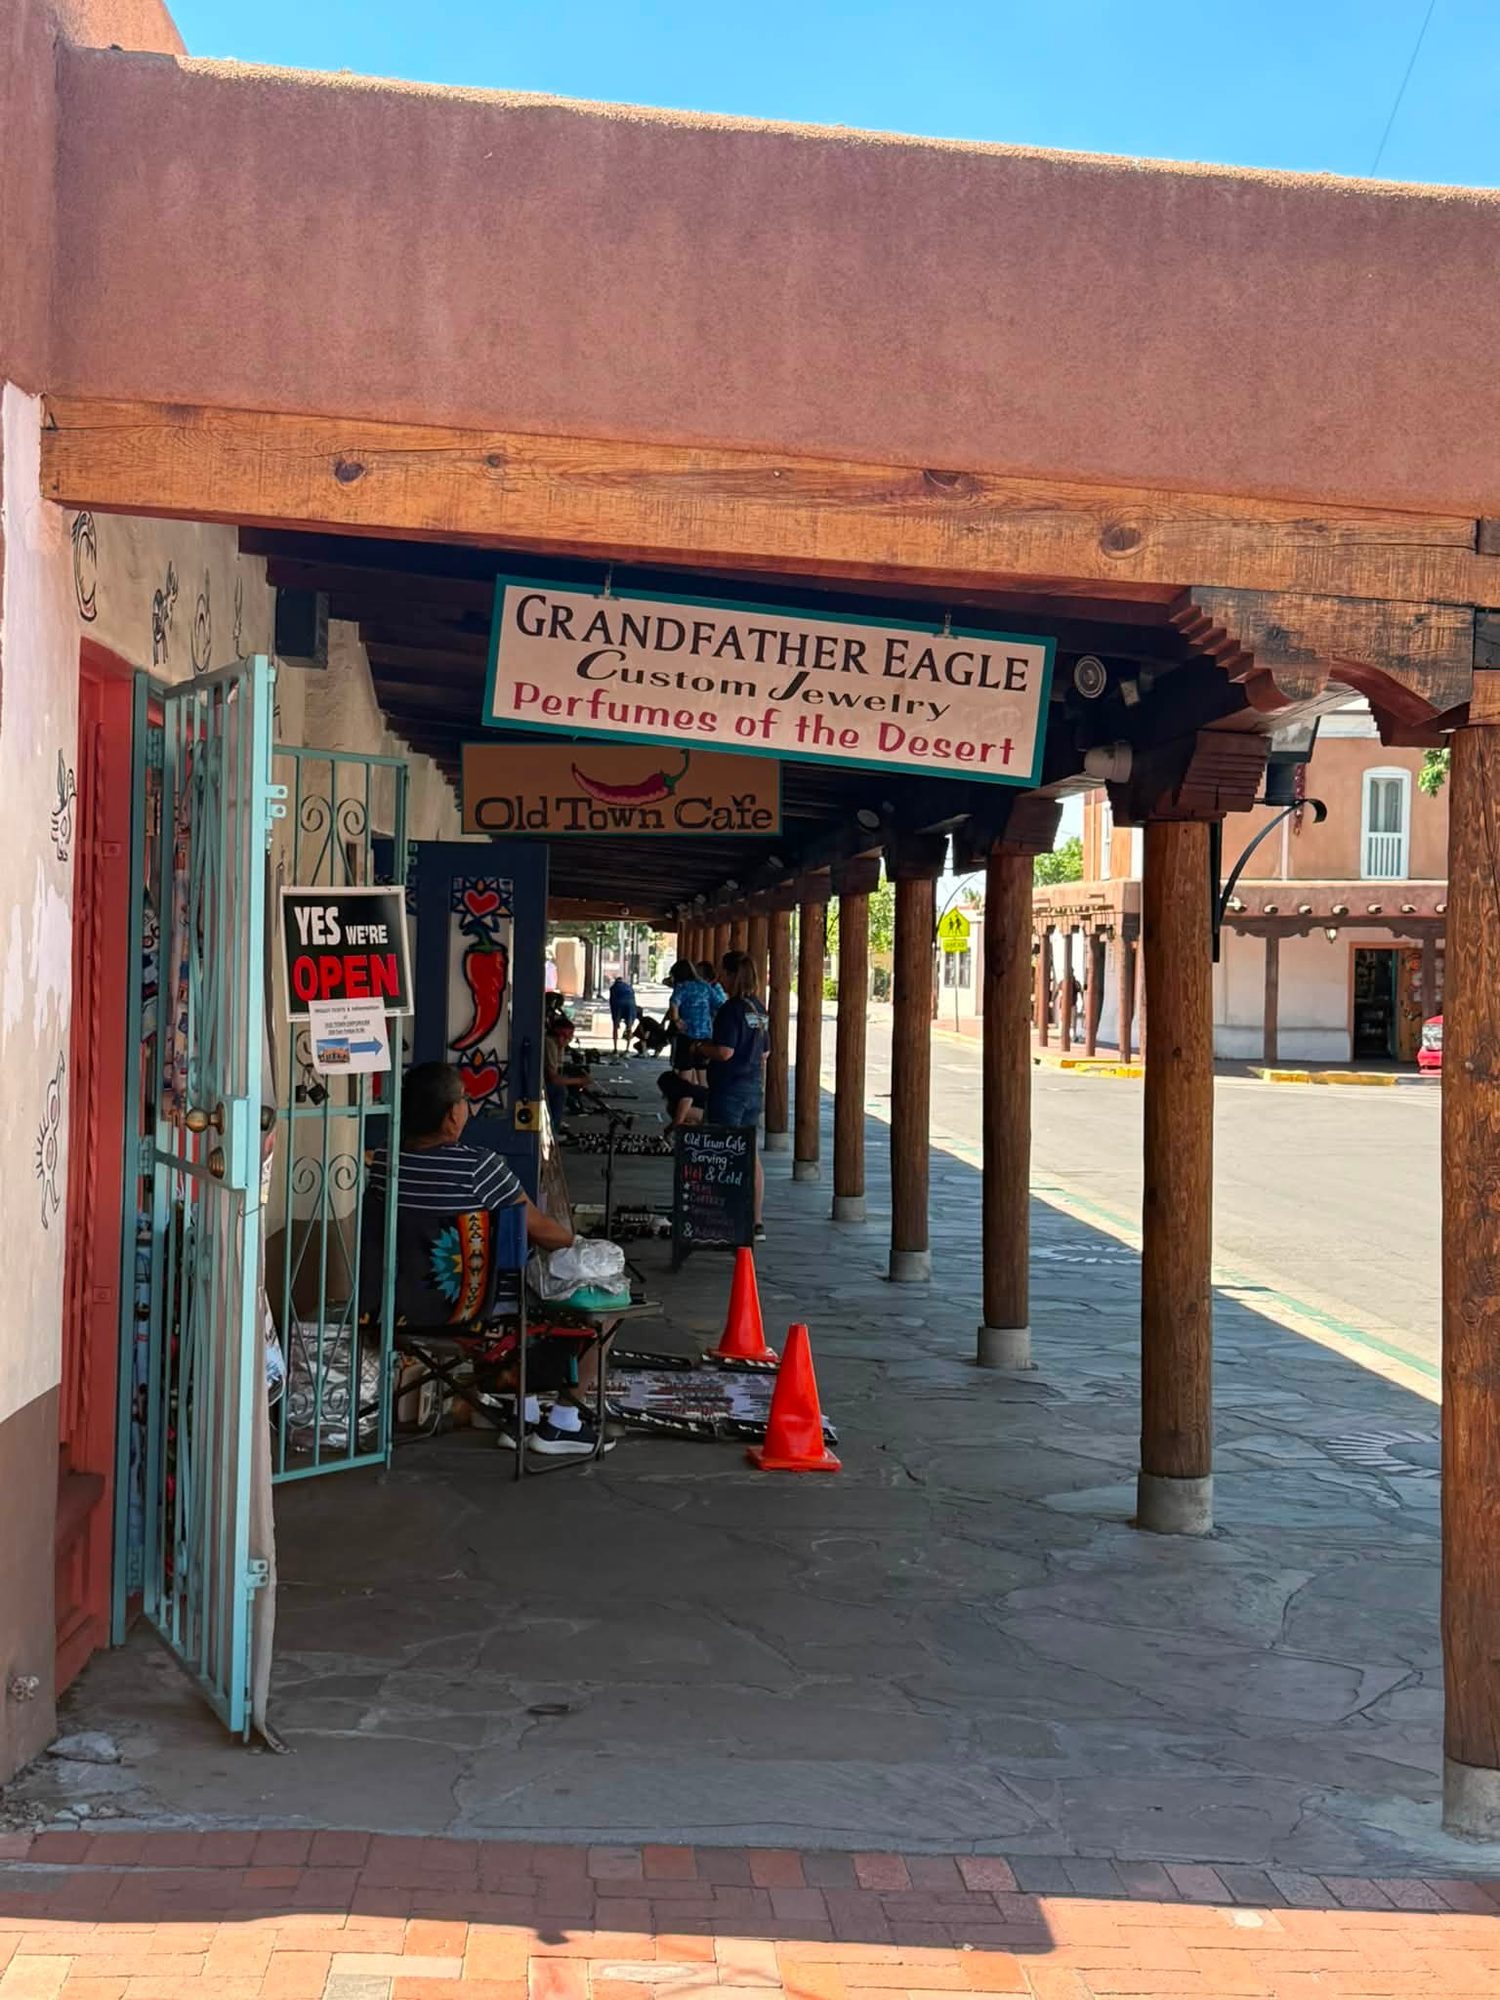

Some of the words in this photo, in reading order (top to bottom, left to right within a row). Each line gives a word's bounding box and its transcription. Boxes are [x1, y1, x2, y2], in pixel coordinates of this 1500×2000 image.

[516, 594, 868, 675] GRANDFATHER
[883, 638, 1029, 692] EAGLE
[576, 649, 757, 698] Custom
[768, 671, 951, 722] Jewelry
[513, 681, 718, 733] Perfumes
[734, 707, 783, 741] of
[795, 714, 860, 749] the
[877, 722, 1015, 765] Desert
[474, 796, 549, 831] Old
[554, 796, 666, 831] Town
[294, 906, 341, 946] YES
[345, 925, 388, 945] WE'RE
[293, 955, 399, 1002] OPEN
[684, 1132, 701, 1147] Old
[702, 1134, 725, 1149] Town
[725, 1135, 747, 1152] Cafe
[705, 1165, 716, 1183] &
[717, 1171, 743, 1185] Cold
